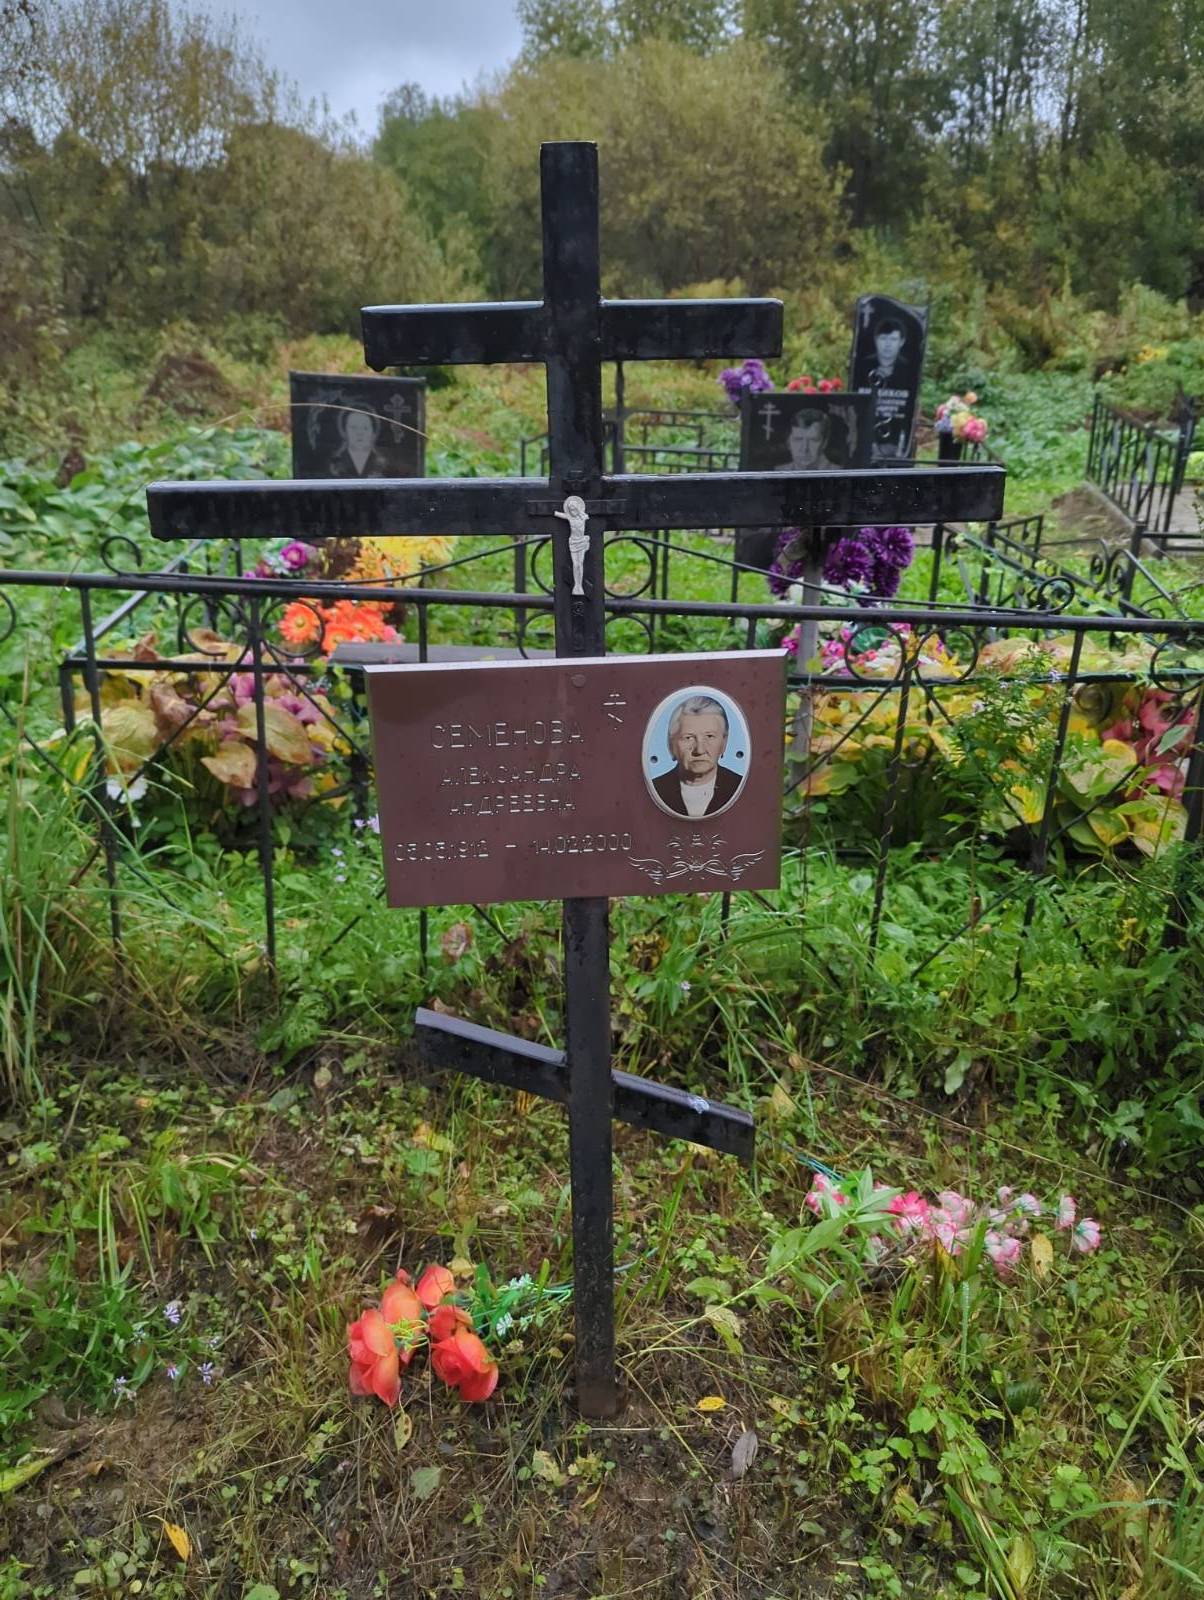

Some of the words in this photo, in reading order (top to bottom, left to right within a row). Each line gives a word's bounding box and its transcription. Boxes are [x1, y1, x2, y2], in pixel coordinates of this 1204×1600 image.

[432, 720, 584, 749] СЕМЕНОВА
[441, 762, 581, 785] АЛЕКСАНДРА
[449, 793, 576, 816] АНДРЕЕВНА
